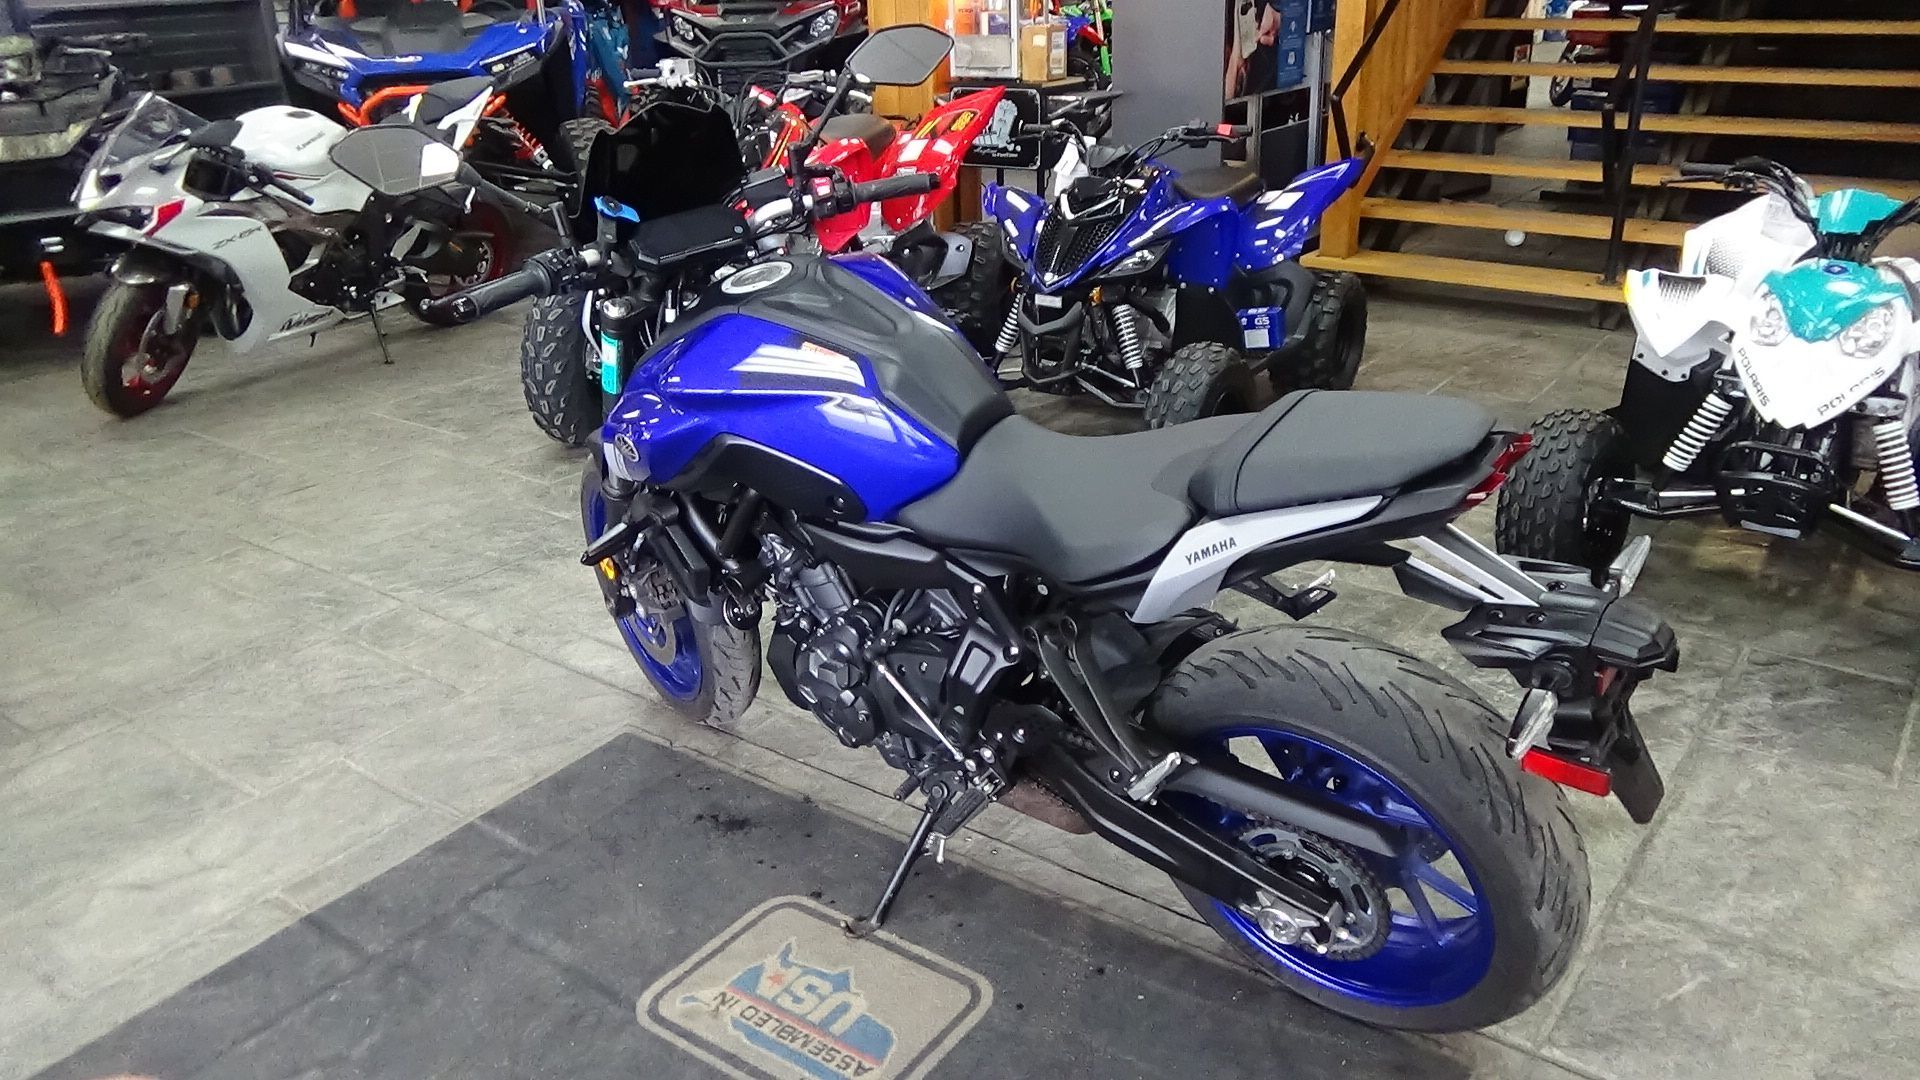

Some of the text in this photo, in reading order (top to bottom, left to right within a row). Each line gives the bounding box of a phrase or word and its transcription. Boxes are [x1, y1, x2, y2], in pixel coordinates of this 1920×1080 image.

[1738, 347, 1770, 407] POLARIS
[1185, 537, 1237, 565] YAMAHA
[756, 956, 867, 1036] USA
[712, 991, 875, 1077] ASSEMBLED IN
